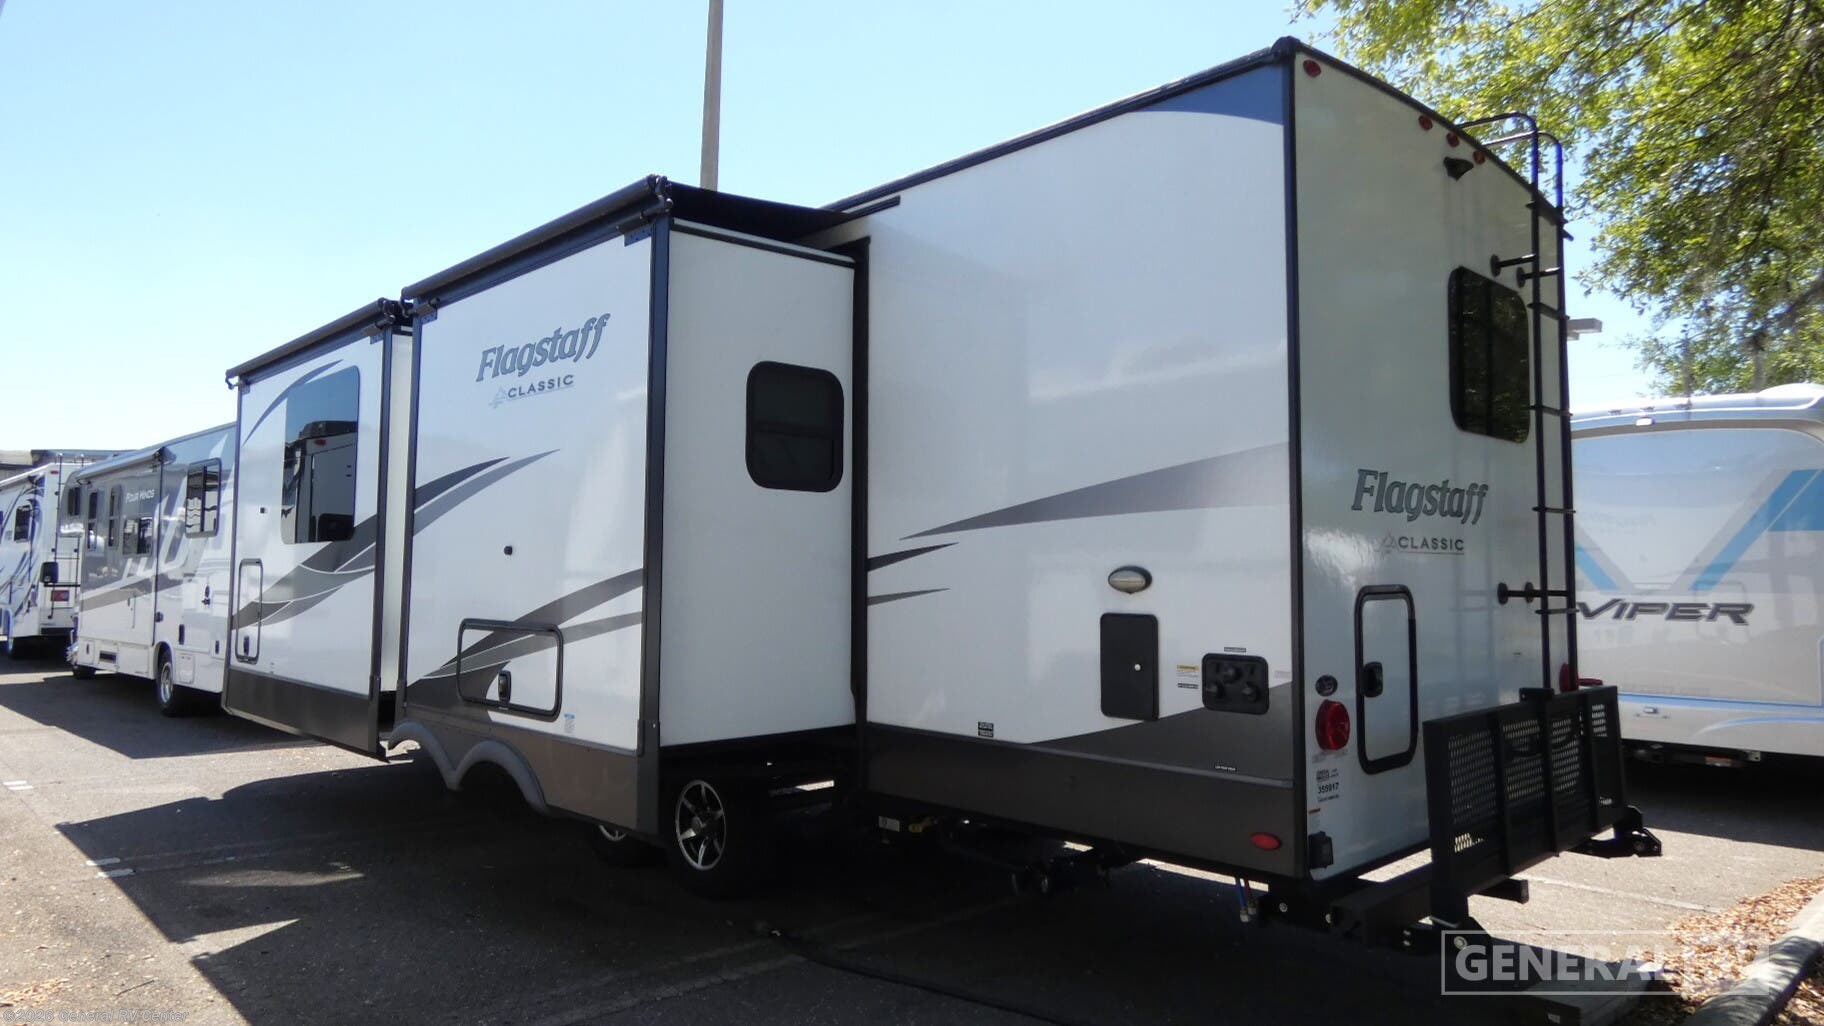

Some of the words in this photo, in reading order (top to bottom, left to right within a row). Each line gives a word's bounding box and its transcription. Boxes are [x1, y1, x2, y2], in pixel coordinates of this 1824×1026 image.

[476, 313, 611, 382] Flagstaff
[507, 374, 575, 398] CLASSIC
[1351, 468, 1489, 525] Flagstaff
[1398, 536, 1464, 551] CLASSIC
[1577, 598, 1755, 626] VIPER
